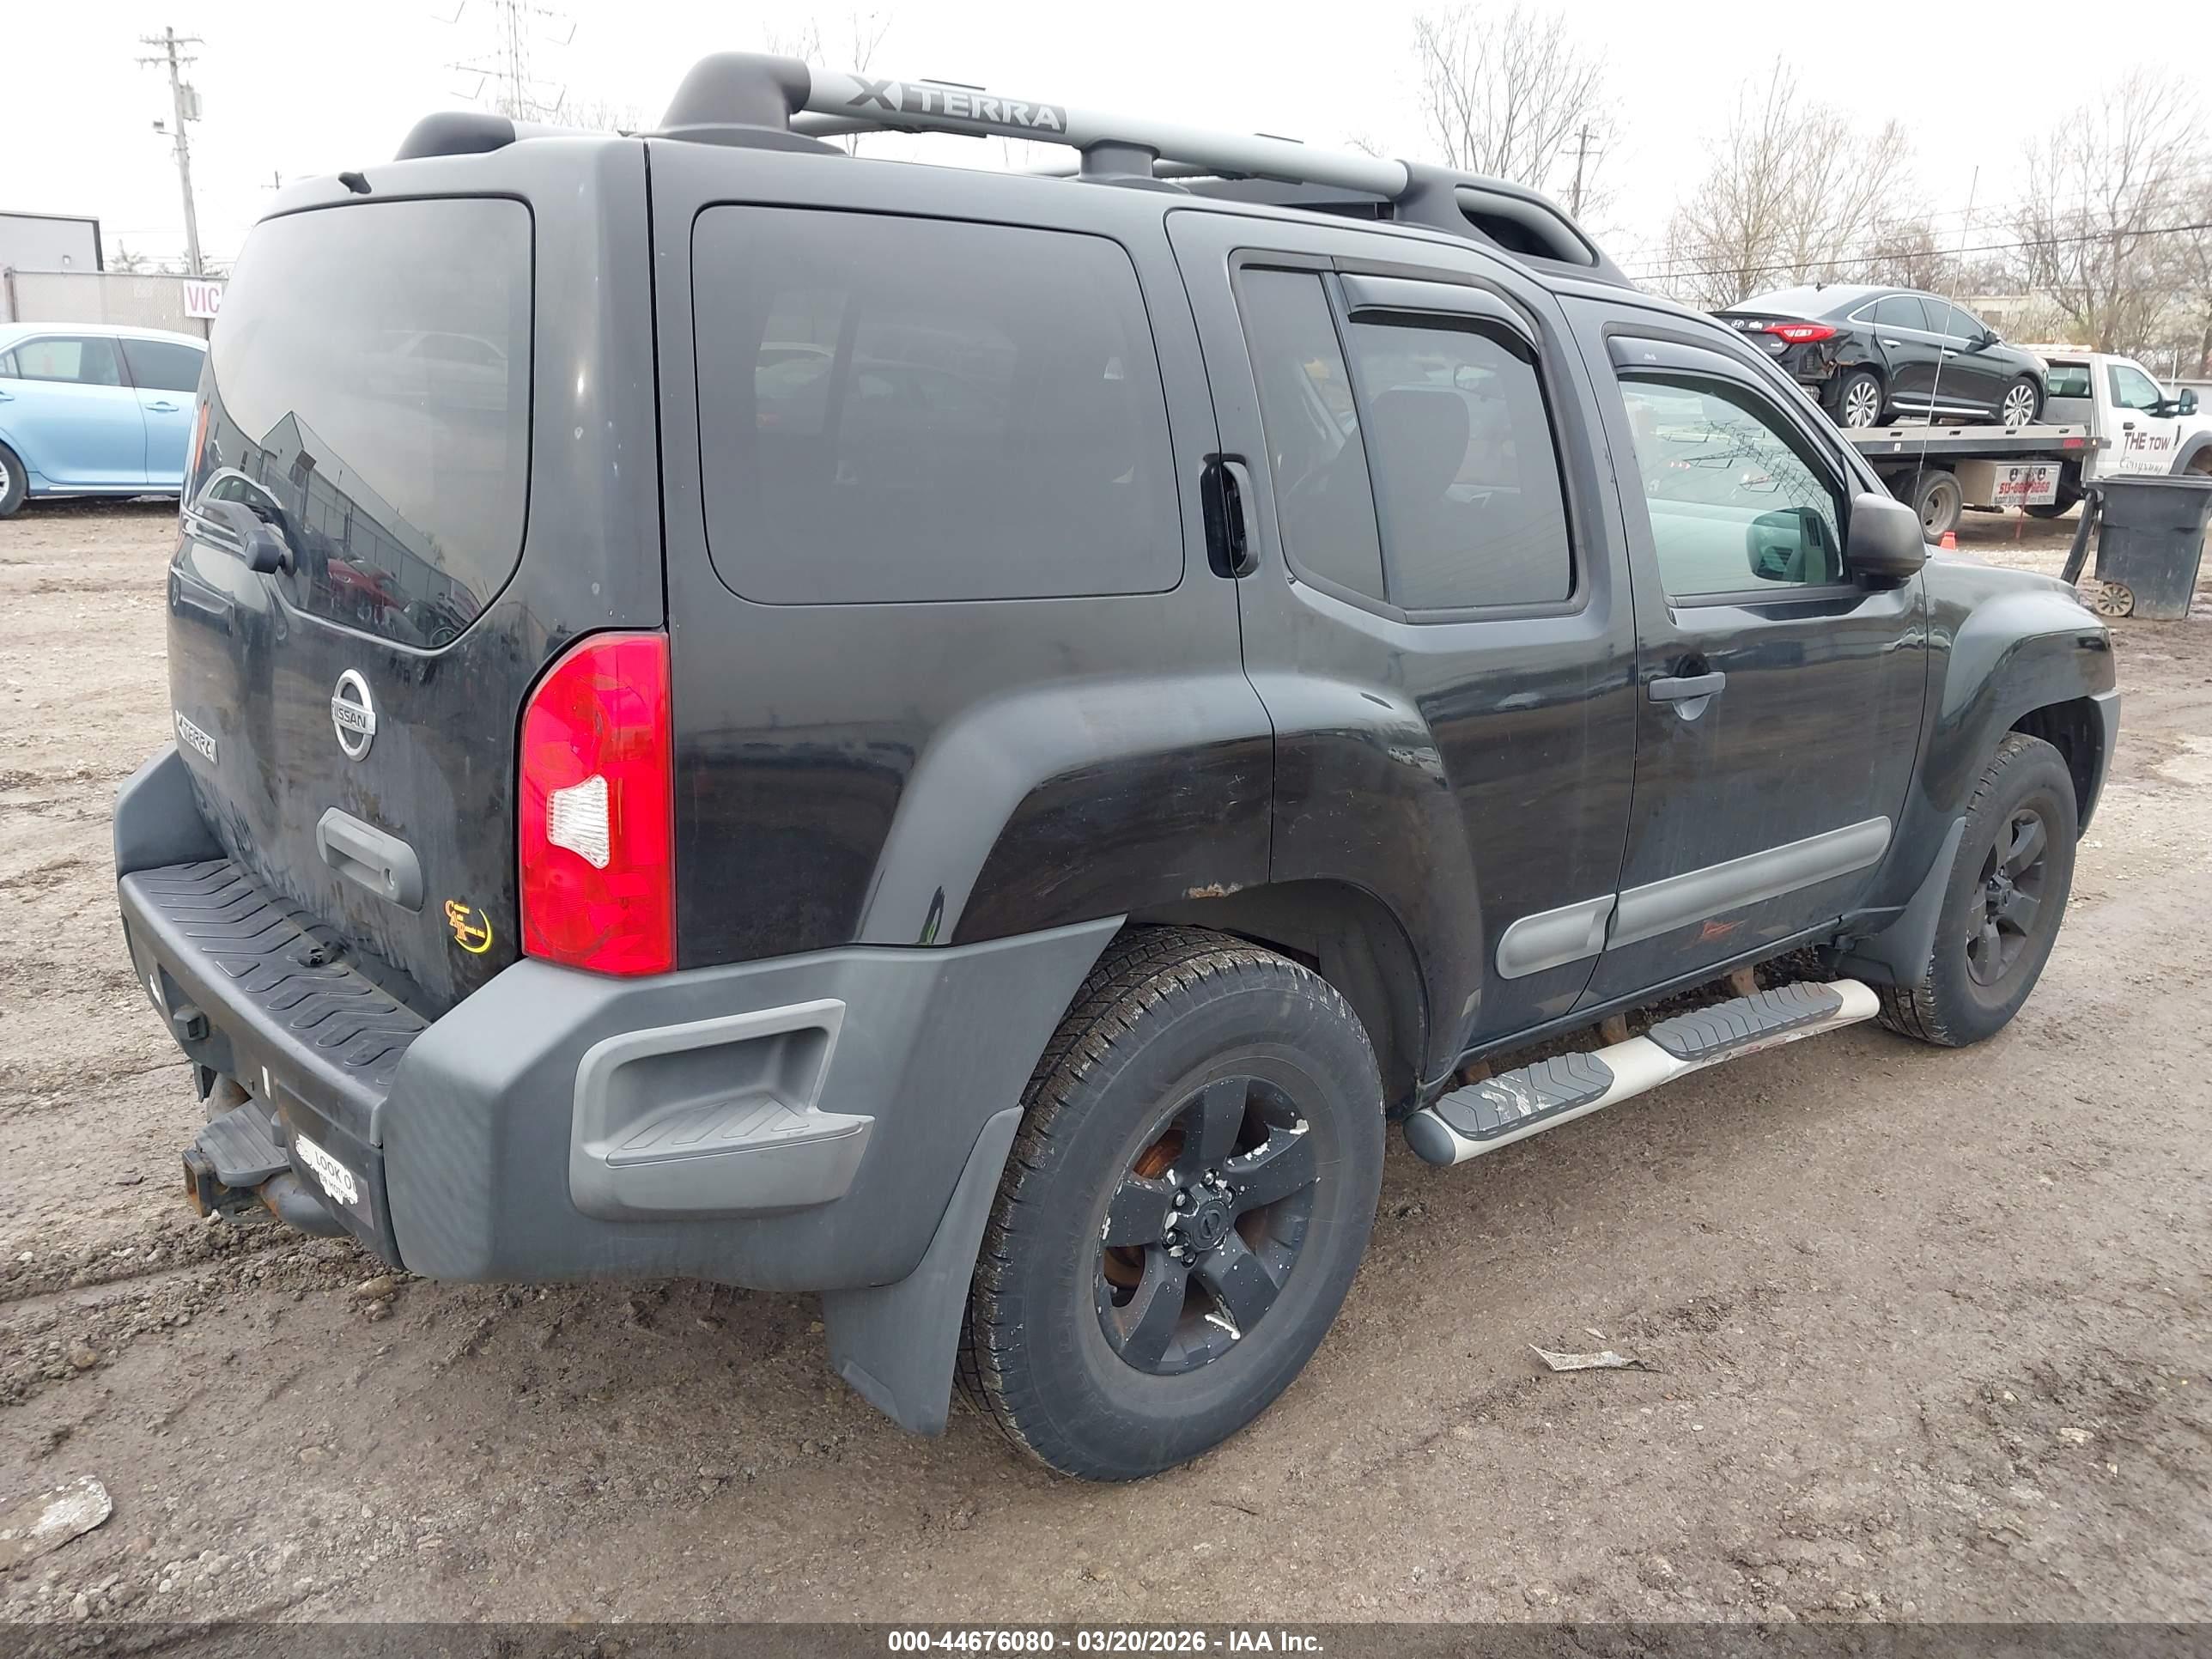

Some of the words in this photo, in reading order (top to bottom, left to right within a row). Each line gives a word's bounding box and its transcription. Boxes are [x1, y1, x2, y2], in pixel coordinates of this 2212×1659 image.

[2124, 432, 2148, 451] THE
[2149, 436, 2172, 451] TOW
[332, 703, 367, 729] NISSAN
[175, 709, 216, 763] XTERRA
[315, 1151, 342, 1183] LOOK
